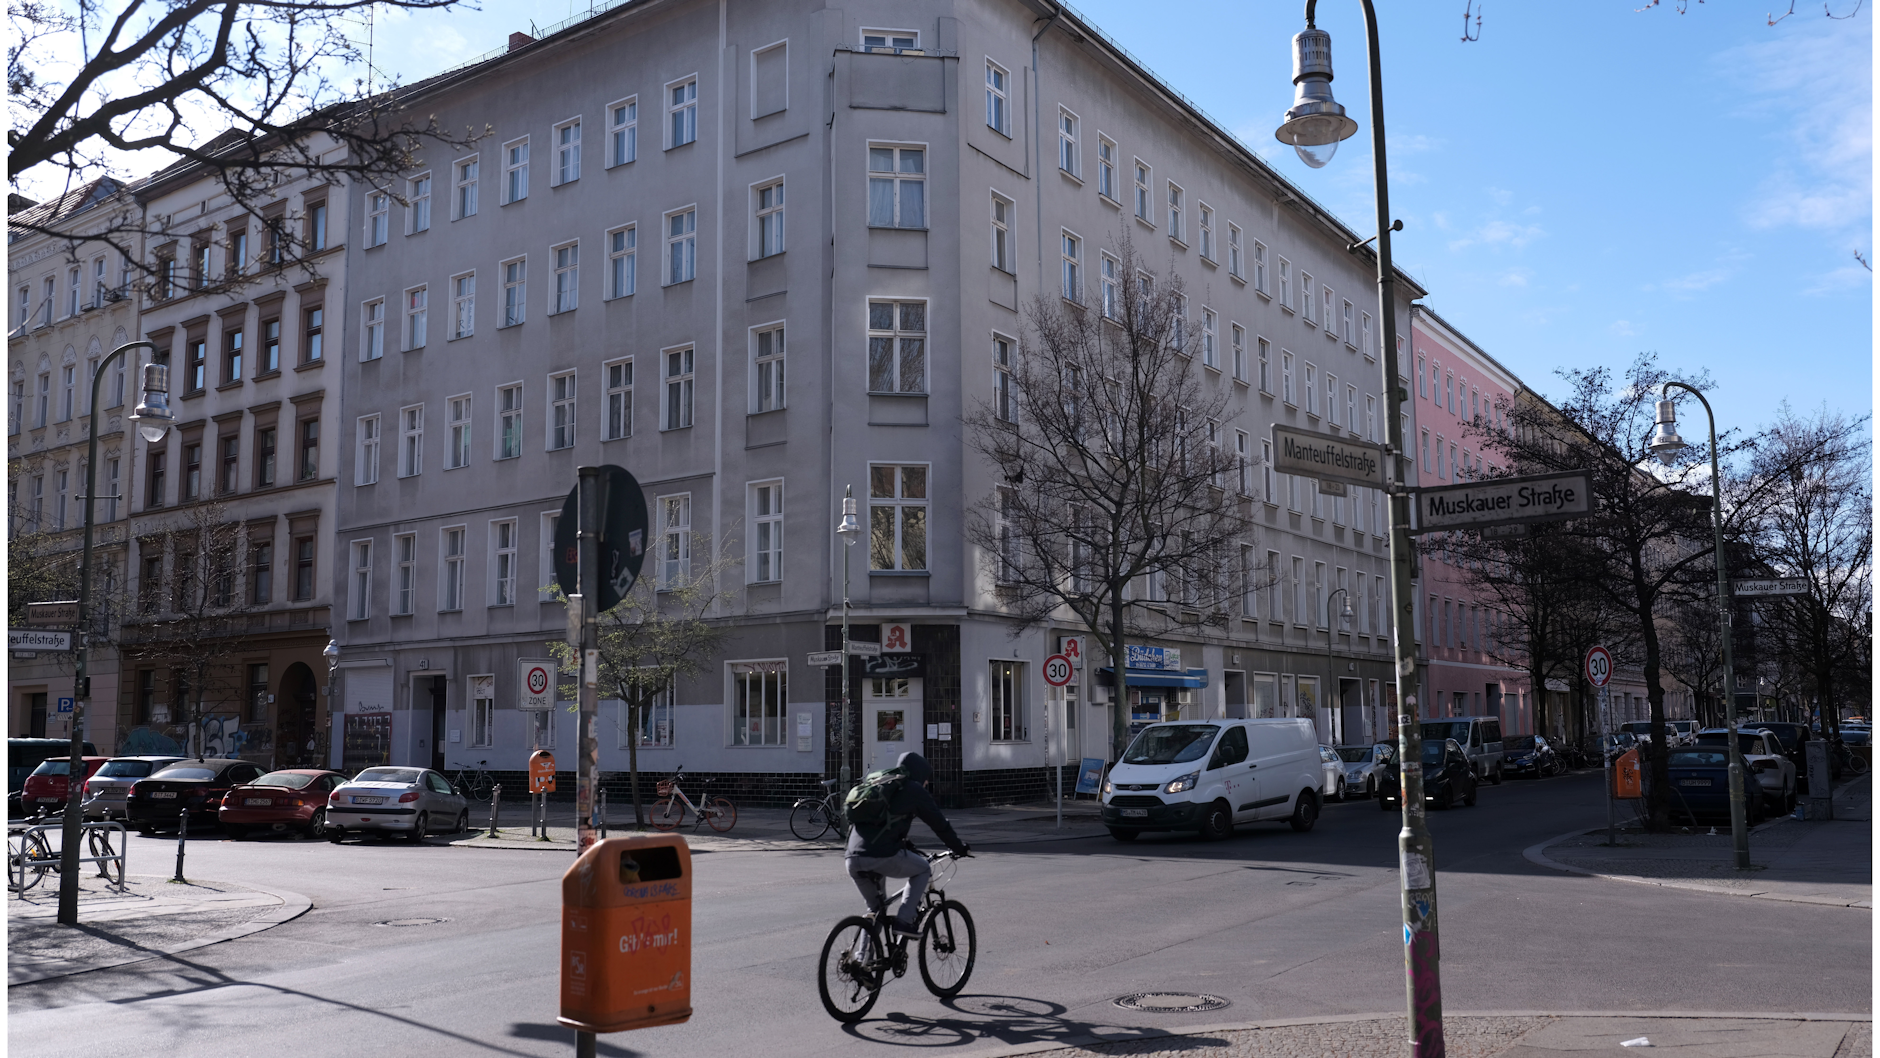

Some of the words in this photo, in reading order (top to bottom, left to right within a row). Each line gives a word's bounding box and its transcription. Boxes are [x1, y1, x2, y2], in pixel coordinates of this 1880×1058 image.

[1284, 436, 1376, 477] Manteuffelstraße
[1429, 493, 1512, 517] Muskauer
[1518, 483, 1575, 510] Straße
[1490, 527, 1498, 536] 18
[1508, 526, 1518, 534] 29
[1734, 582, 1777, 592] Muskauer
[1779, 580, 1807, 591] Straße
[30, 608, 57, 619] Muskauer
[57, 606, 76, 620] Straße
[1130, 646, 1163, 662] Büdchen
[420, 660, 426, 668] 41
[1049, 663, 1067, 678] 30
[1591, 657, 1607, 676] 30
[531, 674, 544, 687] 30
[61, 699, 70, 711] P
[528, 696, 547, 705] ZONE
[652, 928, 678, 947] mir!
